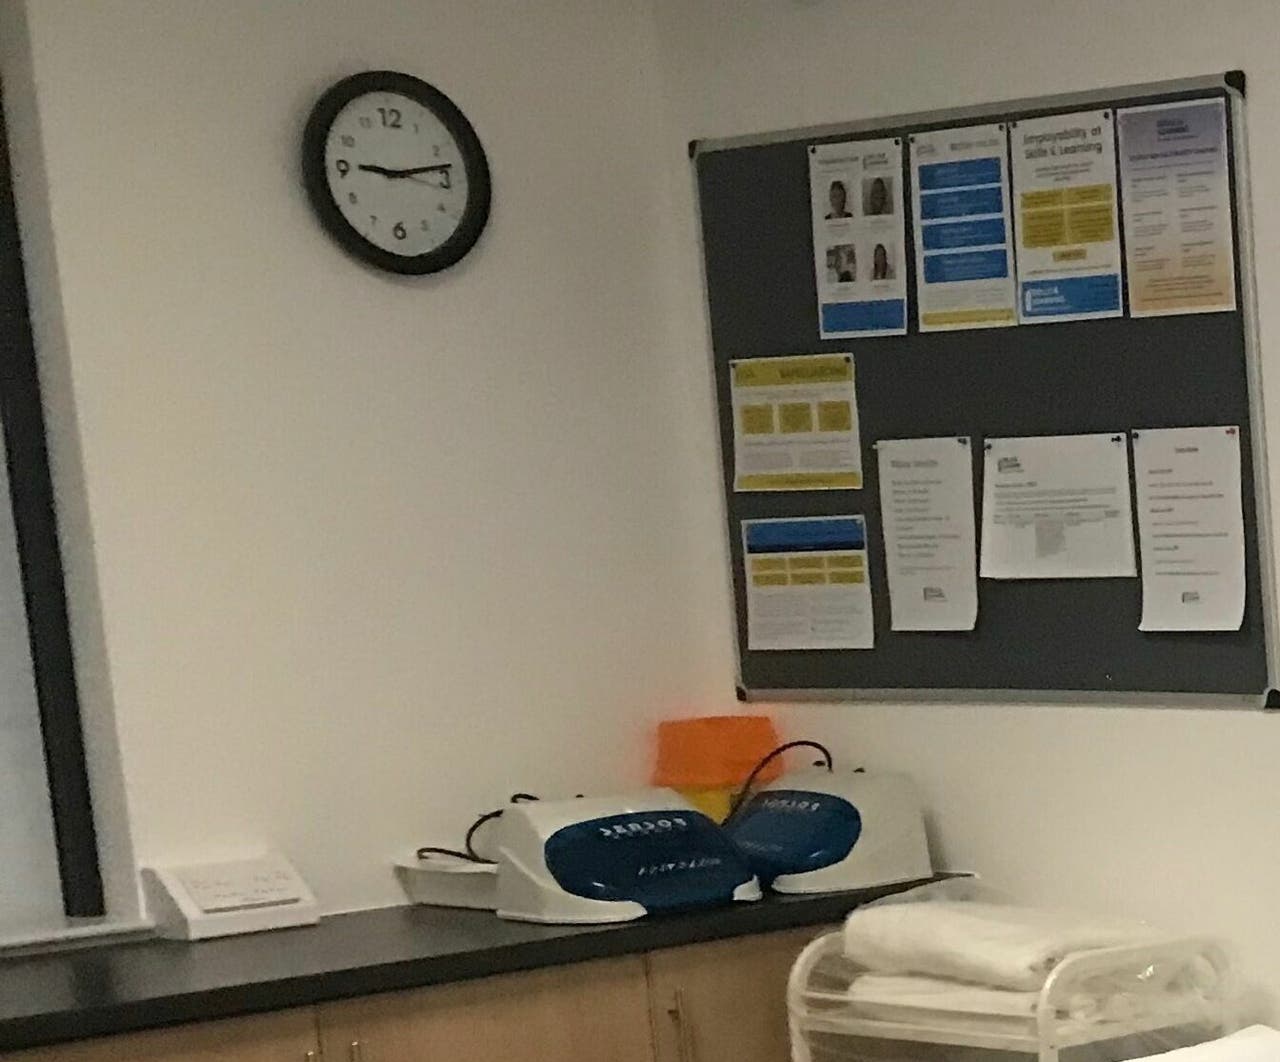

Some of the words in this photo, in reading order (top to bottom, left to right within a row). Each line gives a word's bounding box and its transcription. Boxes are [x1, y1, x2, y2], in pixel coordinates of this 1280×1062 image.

[378, 108, 402, 128] 12
[341, 135, 355, 148] 10
[432, 145, 440, 156] 2
[336, 159, 350, 179] 9
[439, 168, 451, 190] 3
[369, 216, 378, 226] 7
[393, 221, 407, 240] 6
